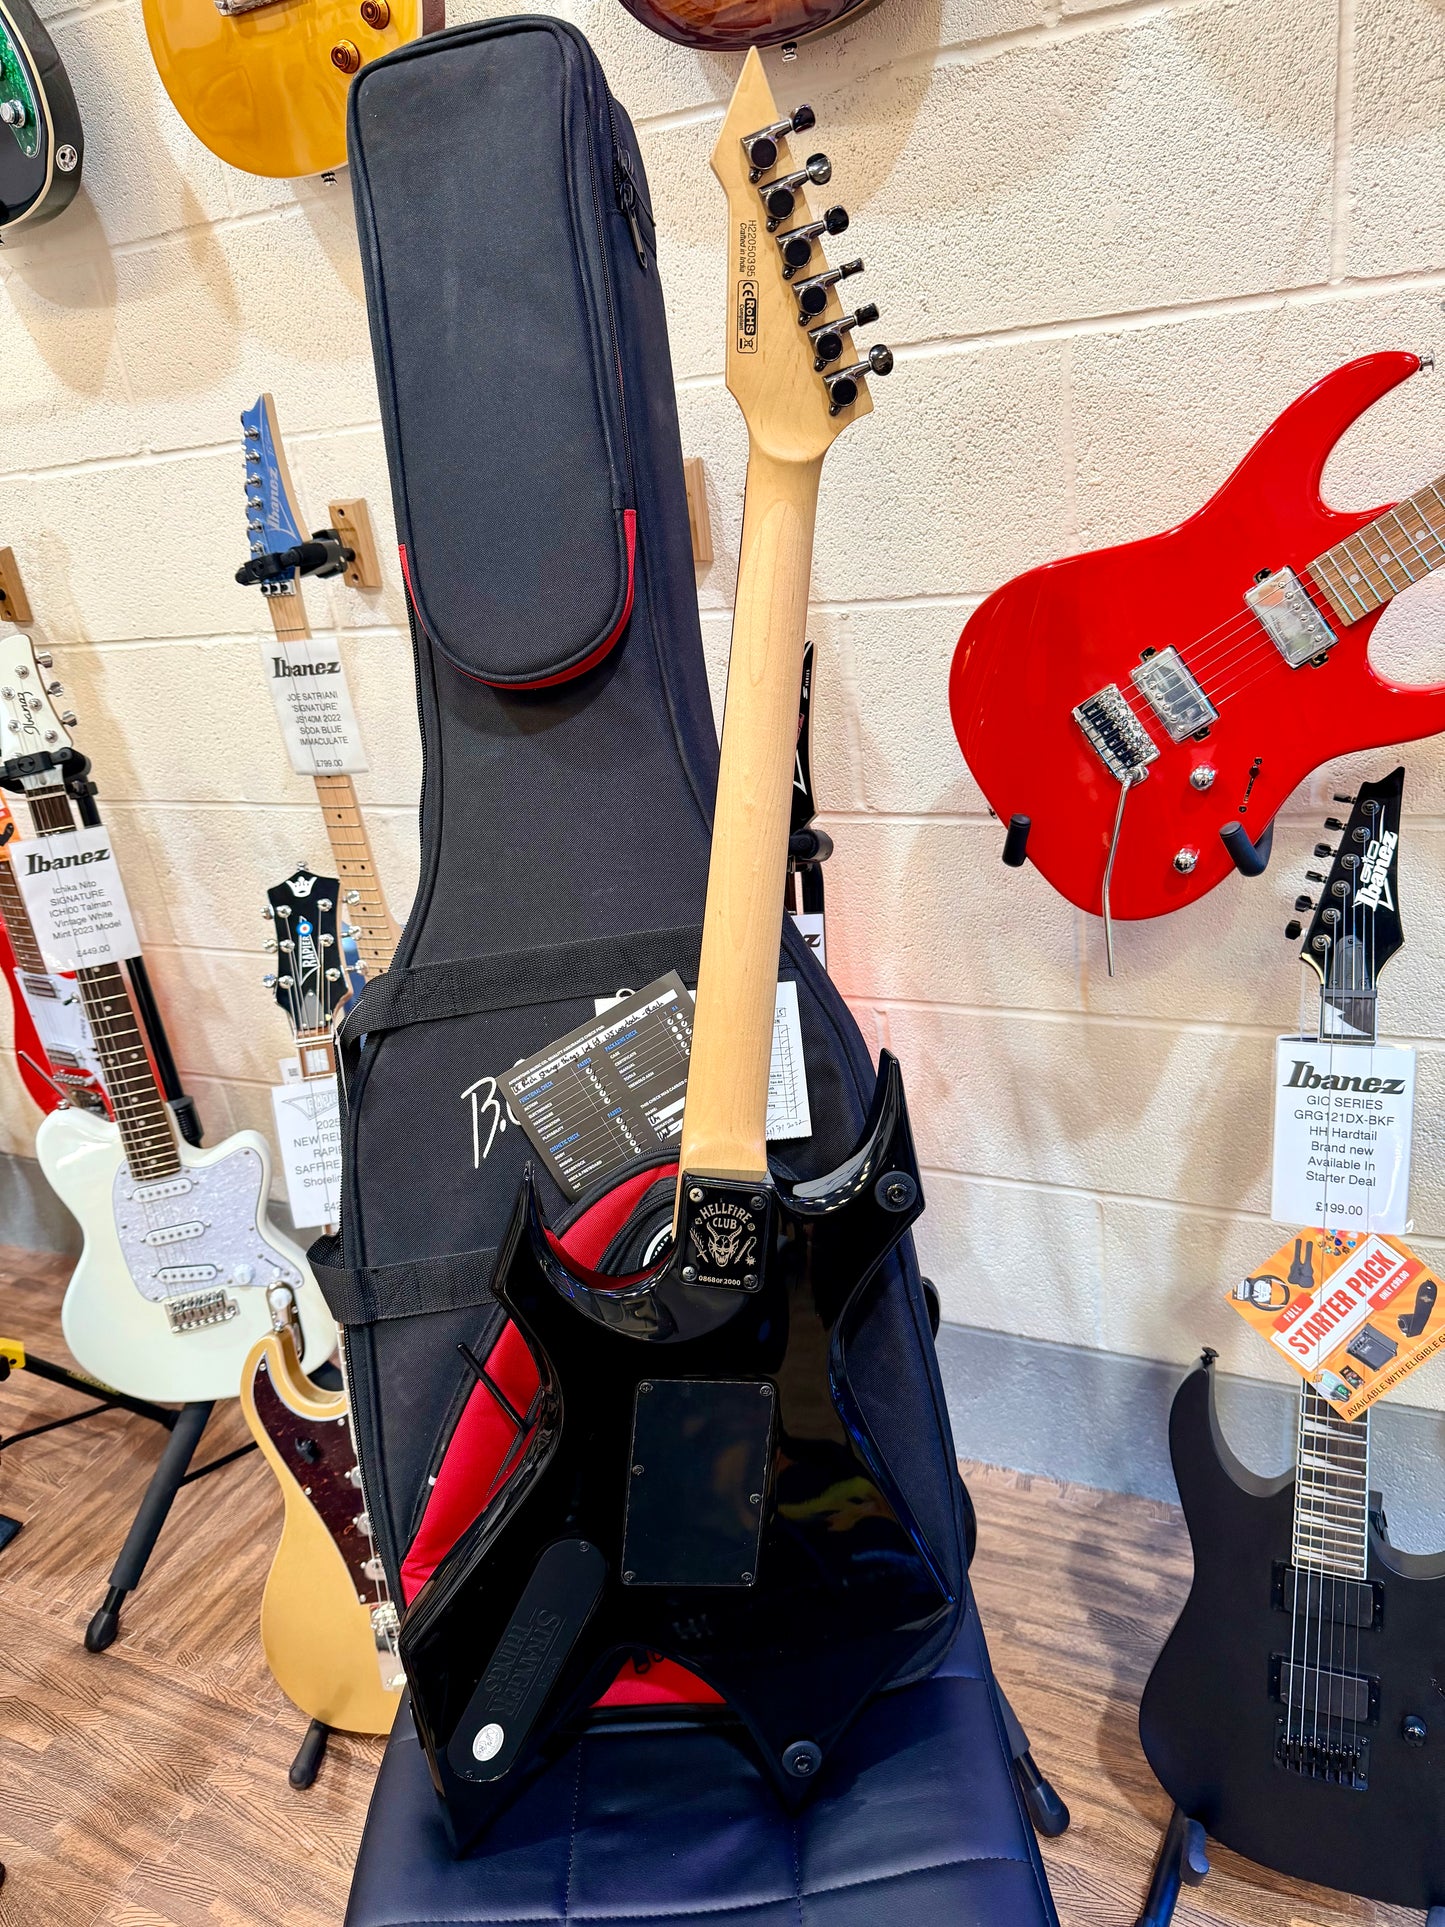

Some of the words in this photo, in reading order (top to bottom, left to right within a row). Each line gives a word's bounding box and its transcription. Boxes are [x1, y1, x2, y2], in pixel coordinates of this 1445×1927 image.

[746, 301, 755, 333] RoHS
[267, 467, 280, 531] Ibanez
[272, 657, 341, 678] Ibanez
[287, 693, 301, 702] JOE
[302, 691, 338, 701] SATRIANI
[17, 690, 41, 736] Ibanez
[323, 714, 342, 723] 2022
[300, 726, 321, 735] SODA
[322, 725, 343, 734] BLUE
[300, 736, 349, 745] IMMACULATE
[316, 759, 343, 768] £799.00
[25, 848, 110, 876] Ibanez
[1354, 830, 1398, 912] Ibanez
[52, 883, 78, 895] Ichika
[79, 880, 97, 892] Nito
[50, 889, 105, 907] SIGNATURE
[80, 900, 113, 914] Talman
[55, 916, 88, 930] Vintage
[89, 910, 113, 923] White
[53, 928, 72, 941] Mint
[73, 925, 95, 937] 2023
[95, 920, 122, 932] Model
[302, 933, 318, 969] RAPIER
[1282, 1060, 1406, 1095] Ibanez
[1334, 1097, 1384, 1111] SERIES
[316, 1119, 342, 1130] 2025
[1294, 1109, 1395, 1127] GRG121DX-BKF
[293, 1135, 320, 1148] NEW
[1309, 1126, 1328, 1137] HH
[1332, 1127, 1378, 1141] Hardtail
[1311, 1141, 1346, 1154] Brand
[1349, 1146, 1374, 1156] new
[295, 1160, 340, 1176] SAFFIRE
[1307, 1156, 1361, 1170] Available
[1365, 1161, 1376, 1171] In
[1306, 1171, 1345, 1184] Starter
[1348, 1175, 1376, 1187] Deal
[1315, 1202, 1363, 1216] £199.00
[712, 1217, 738, 1230] CLUB
[1379, 1286, 1394, 1300] ONLY
[1391, 1270, 1410, 1290] £99.00
[1288, 1289, 1358, 1356] STARTER
[1345, 1249, 1397, 1298] PACK
[1283, 1305, 1303, 1323] FULL
[1347, 1383, 1388, 1417] AVAILABLE
[1386, 1366, 1407, 1390] WITH
[1405, 1340, 1441, 1370] ELIGIBLE
[486, 1624, 530, 1694] THINGS
[489, 1610, 561, 1716] STRANGER
